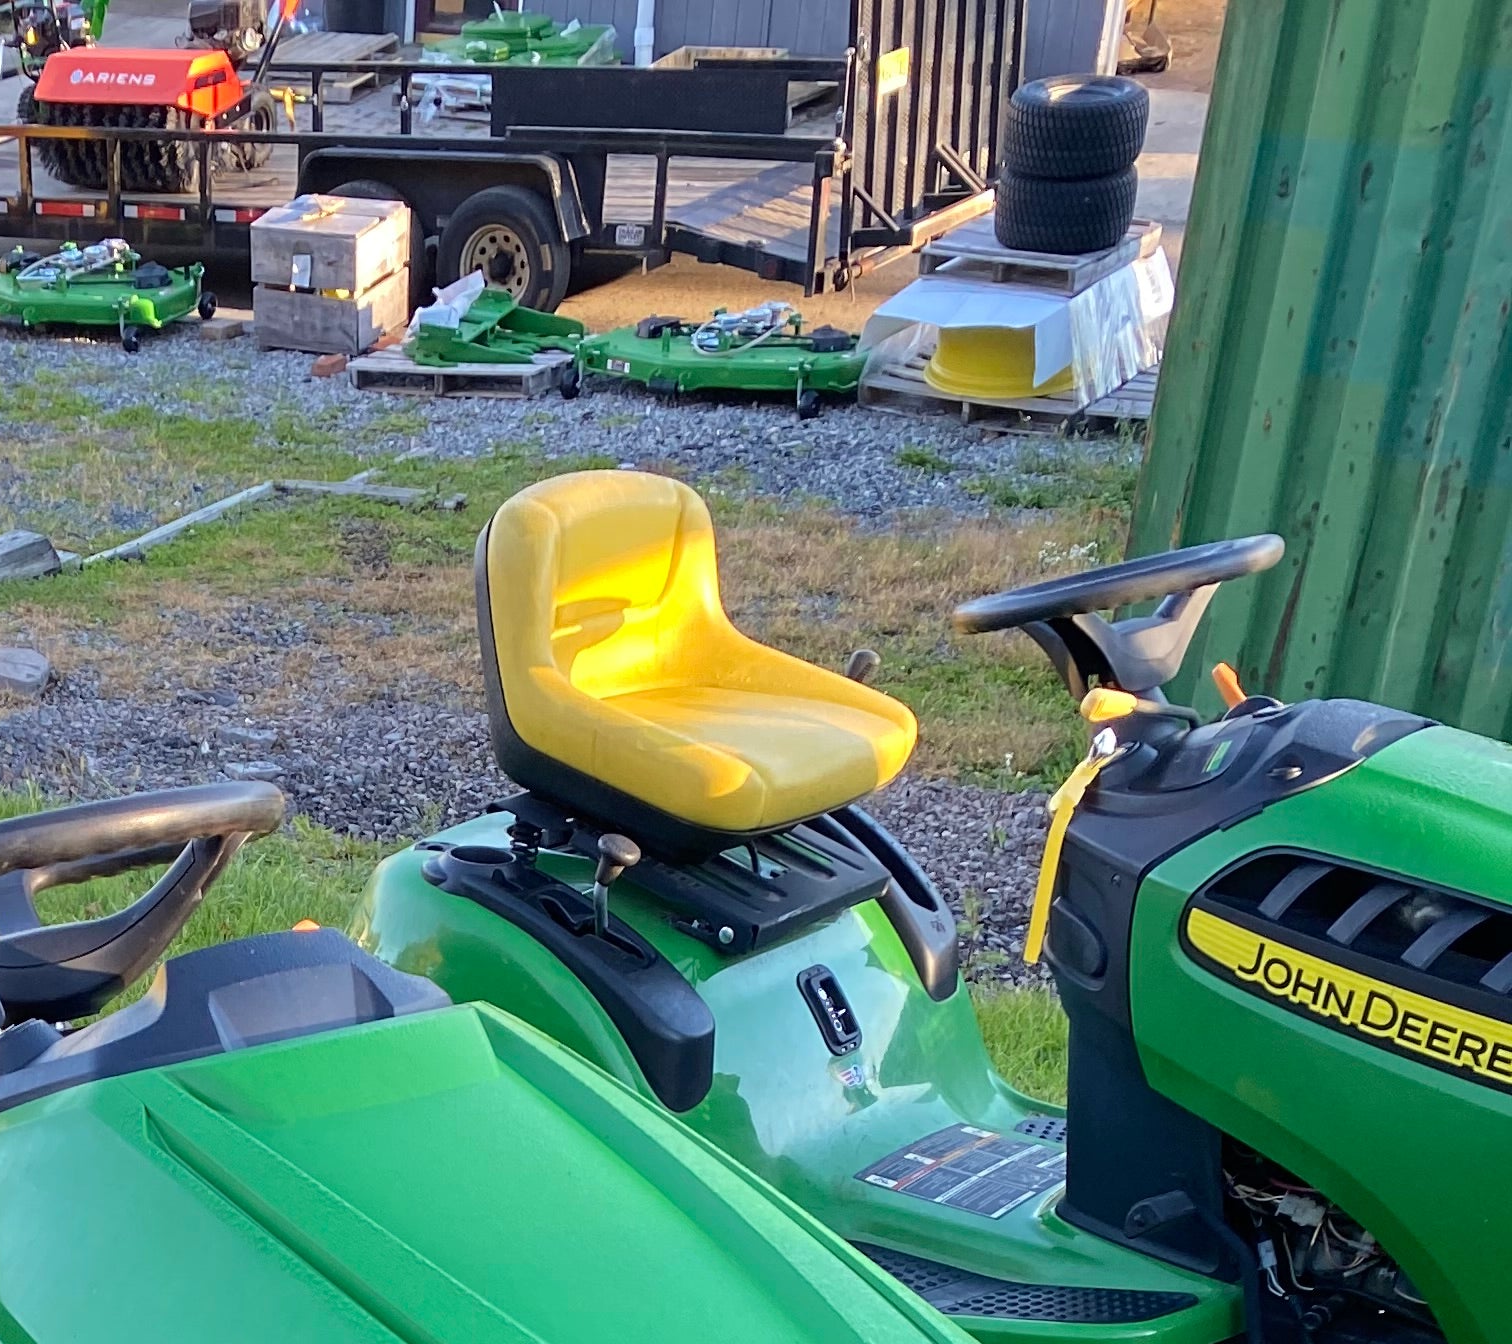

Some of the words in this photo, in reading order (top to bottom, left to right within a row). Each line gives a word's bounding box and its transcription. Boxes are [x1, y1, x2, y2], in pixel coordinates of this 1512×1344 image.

[82, 71, 156, 86] ARIENS
[1238, 942, 1355, 1019] JOHN
[1360, 989, 1512, 1077] DEERE
